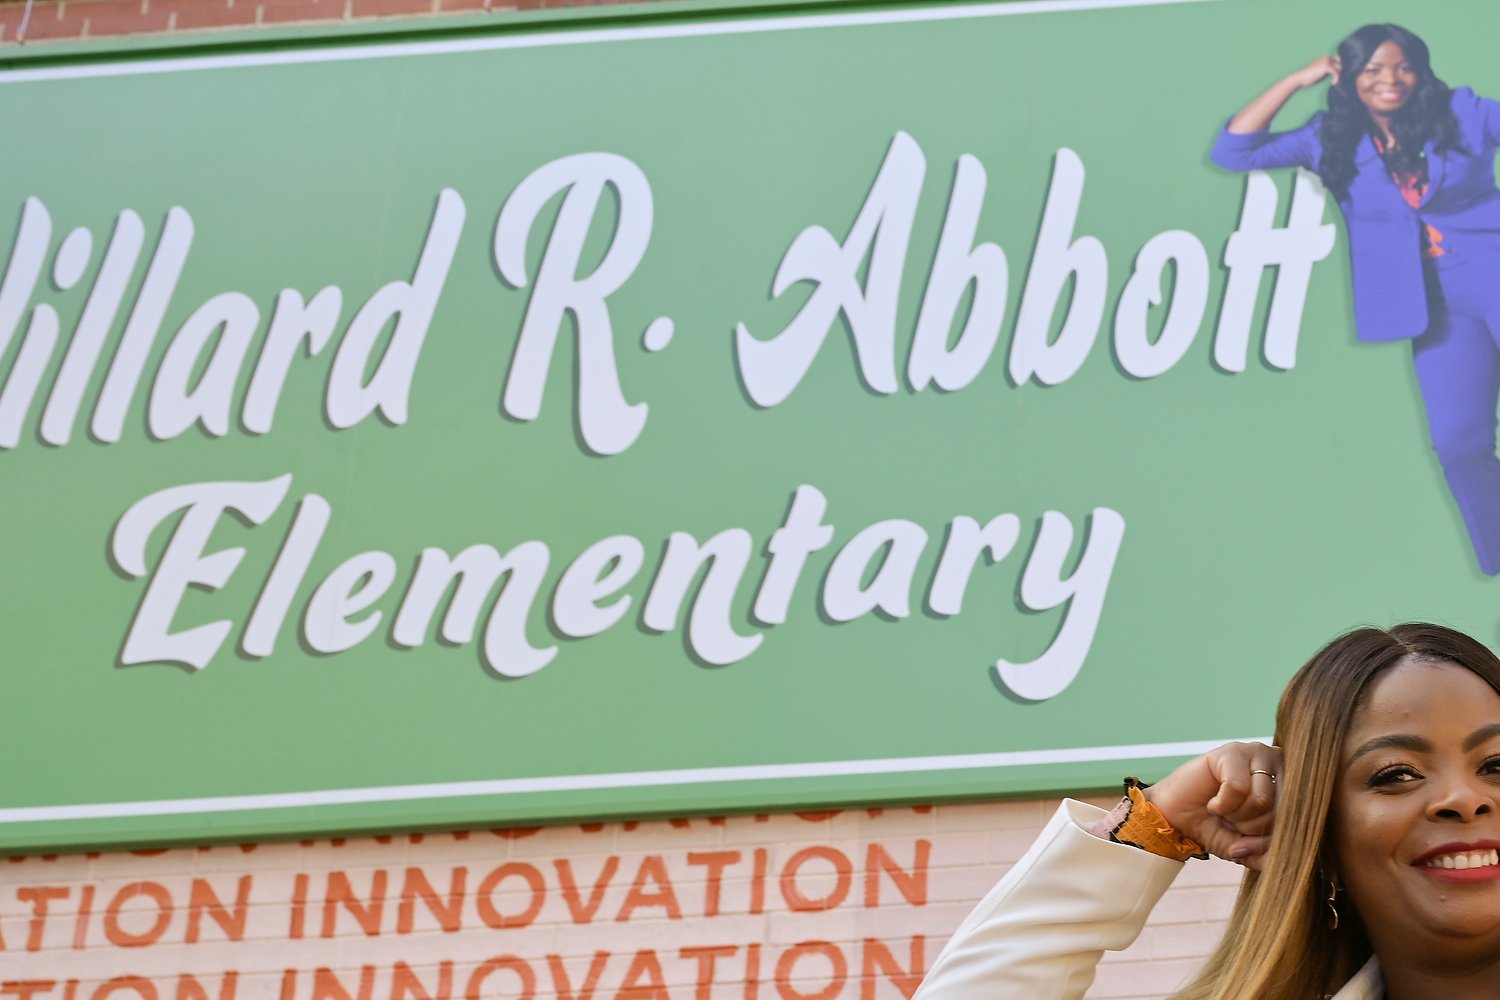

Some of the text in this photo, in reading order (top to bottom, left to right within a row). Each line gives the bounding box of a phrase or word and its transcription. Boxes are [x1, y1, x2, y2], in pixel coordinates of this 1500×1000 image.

[493, 152, 674, 455] R.
[736, 130, 1336, 407] Abbott
[110, 474, 1125, 701] Elementary
[290, 840, 932, 940] INNOVATION
